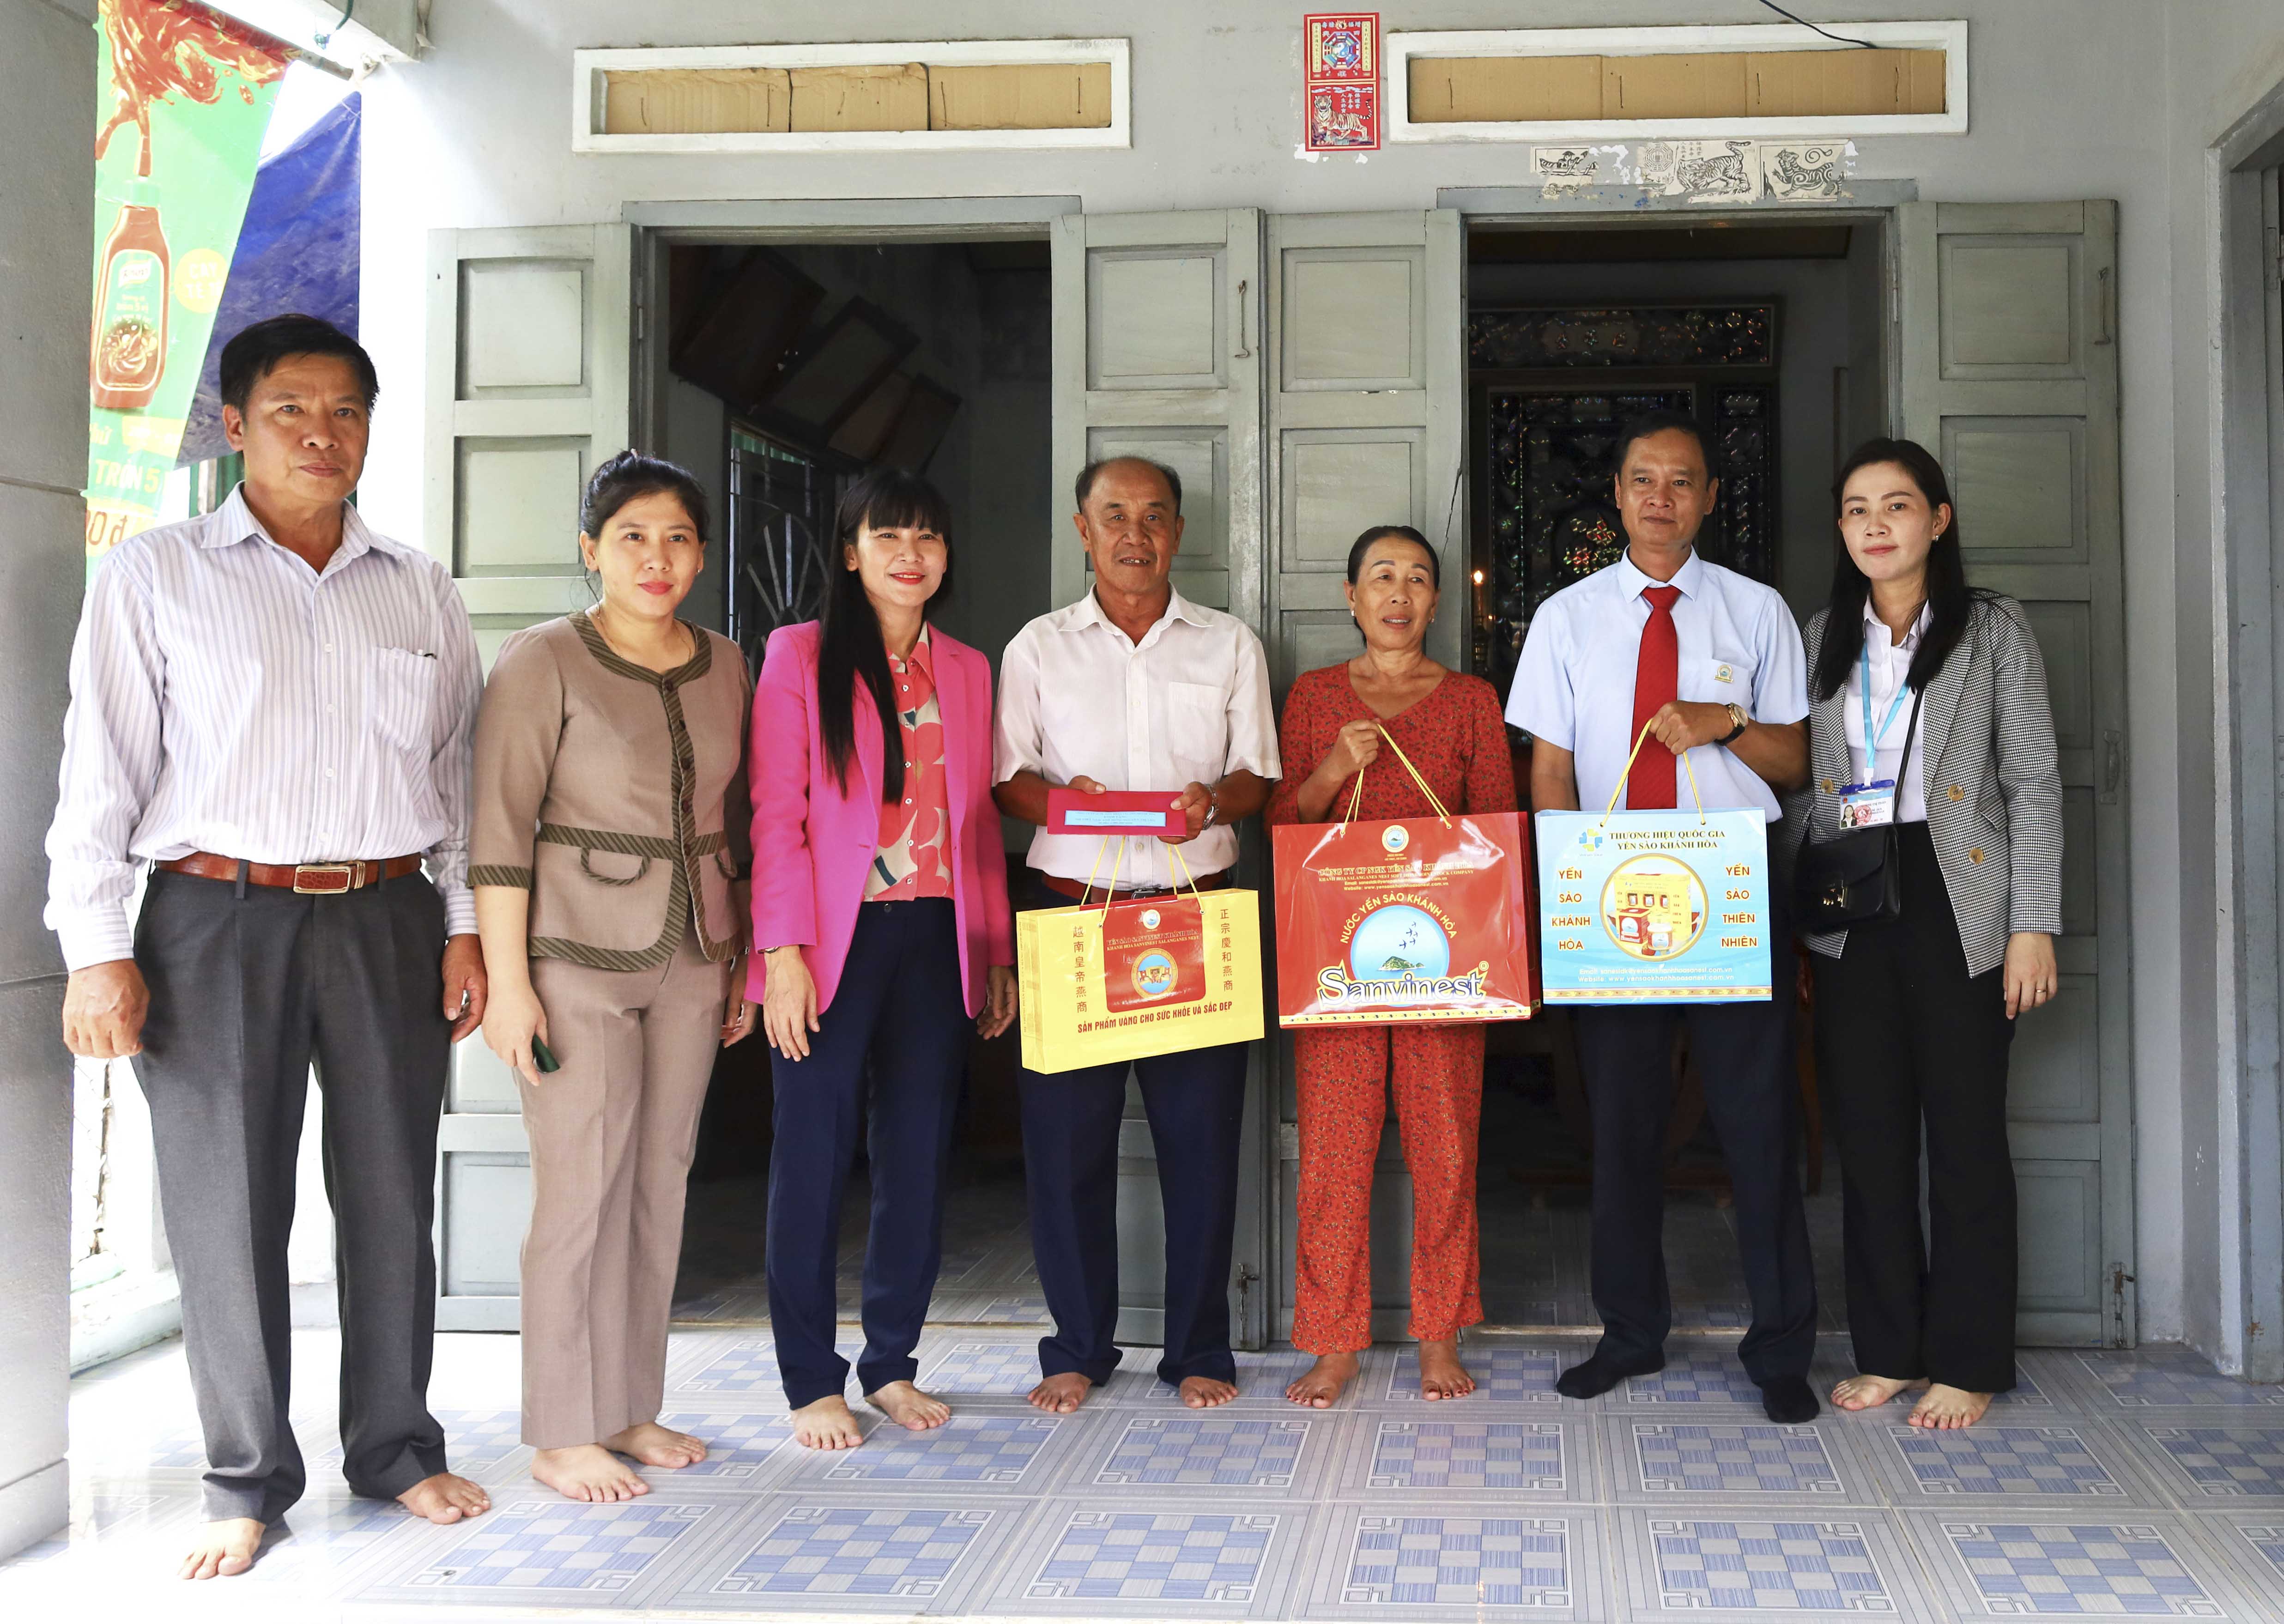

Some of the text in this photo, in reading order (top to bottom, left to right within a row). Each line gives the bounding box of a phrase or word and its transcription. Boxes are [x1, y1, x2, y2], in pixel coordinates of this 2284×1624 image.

[144, 467, 161, 493] 5
[1559, 867, 1582, 879] YẾN
[1725, 863, 1750, 876] YẾN
[1559, 891, 1582, 903] SÀO
[1726, 888, 1750, 899] SÀO
[1340, 891, 1457, 944] NƯỚC YẾN SÀO KHÁNH HÒA
[1552, 915, 1590, 927] KHÁNH
[1722, 912, 1755, 923] THIÊN
[1559, 938, 1584, 950] HÒA
[1721, 935, 1757, 947] NHIÊN
[1220, 909, 1233, 992] 正宗慶和燕商
[1073, 926, 1087, 1013] 越南皇帝燕商
[1318, 963, 1485, 1008] Sanvinest
[1078, 1018, 1092, 1033] SẢN
[1095, 1016, 1116, 1030] PHẨM
[1119, 1015, 1138, 1027] VÀNG
[1140, 1013, 1154, 1024] CHO
[1157, 1007, 1170, 1020] SỨC
[1173, 1004, 1191, 1018] KHỎE
[1193, 1003, 1202, 1015] VÀ
[1204, 1001, 1217, 1013] SẮC
